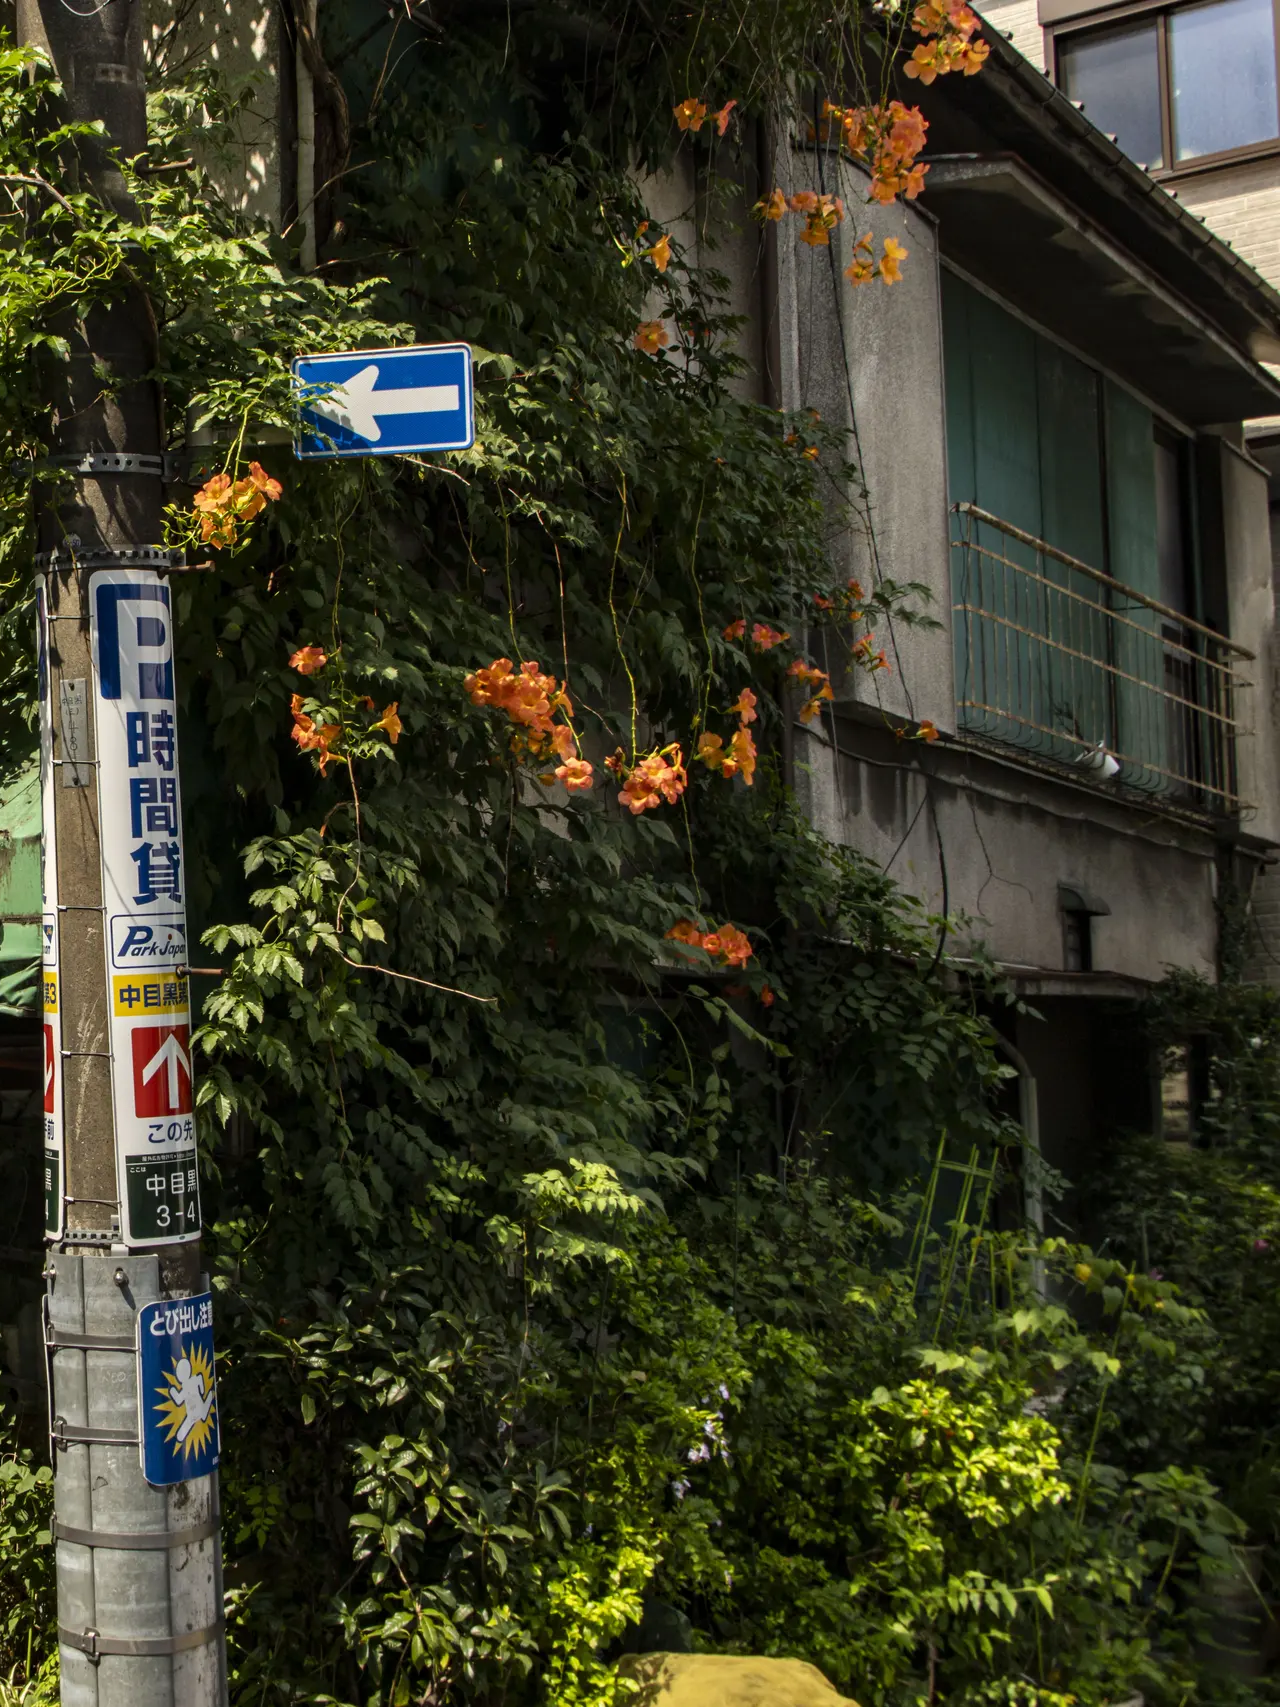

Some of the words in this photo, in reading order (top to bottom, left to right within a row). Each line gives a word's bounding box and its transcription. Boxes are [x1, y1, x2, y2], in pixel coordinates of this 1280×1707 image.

[117, 599, 172, 700] P
[127, 709, 182, 905] 時間貸
[117, 925, 160, 957] Park
[160, 934, 186, 958] Japa
[147, 1118, 193, 1144] この先
[130, 1166, 147, 1174] ここは
[146, 1169, 196, 1197] 中目黒
[156, 1200, 196, 1227] 3-4
